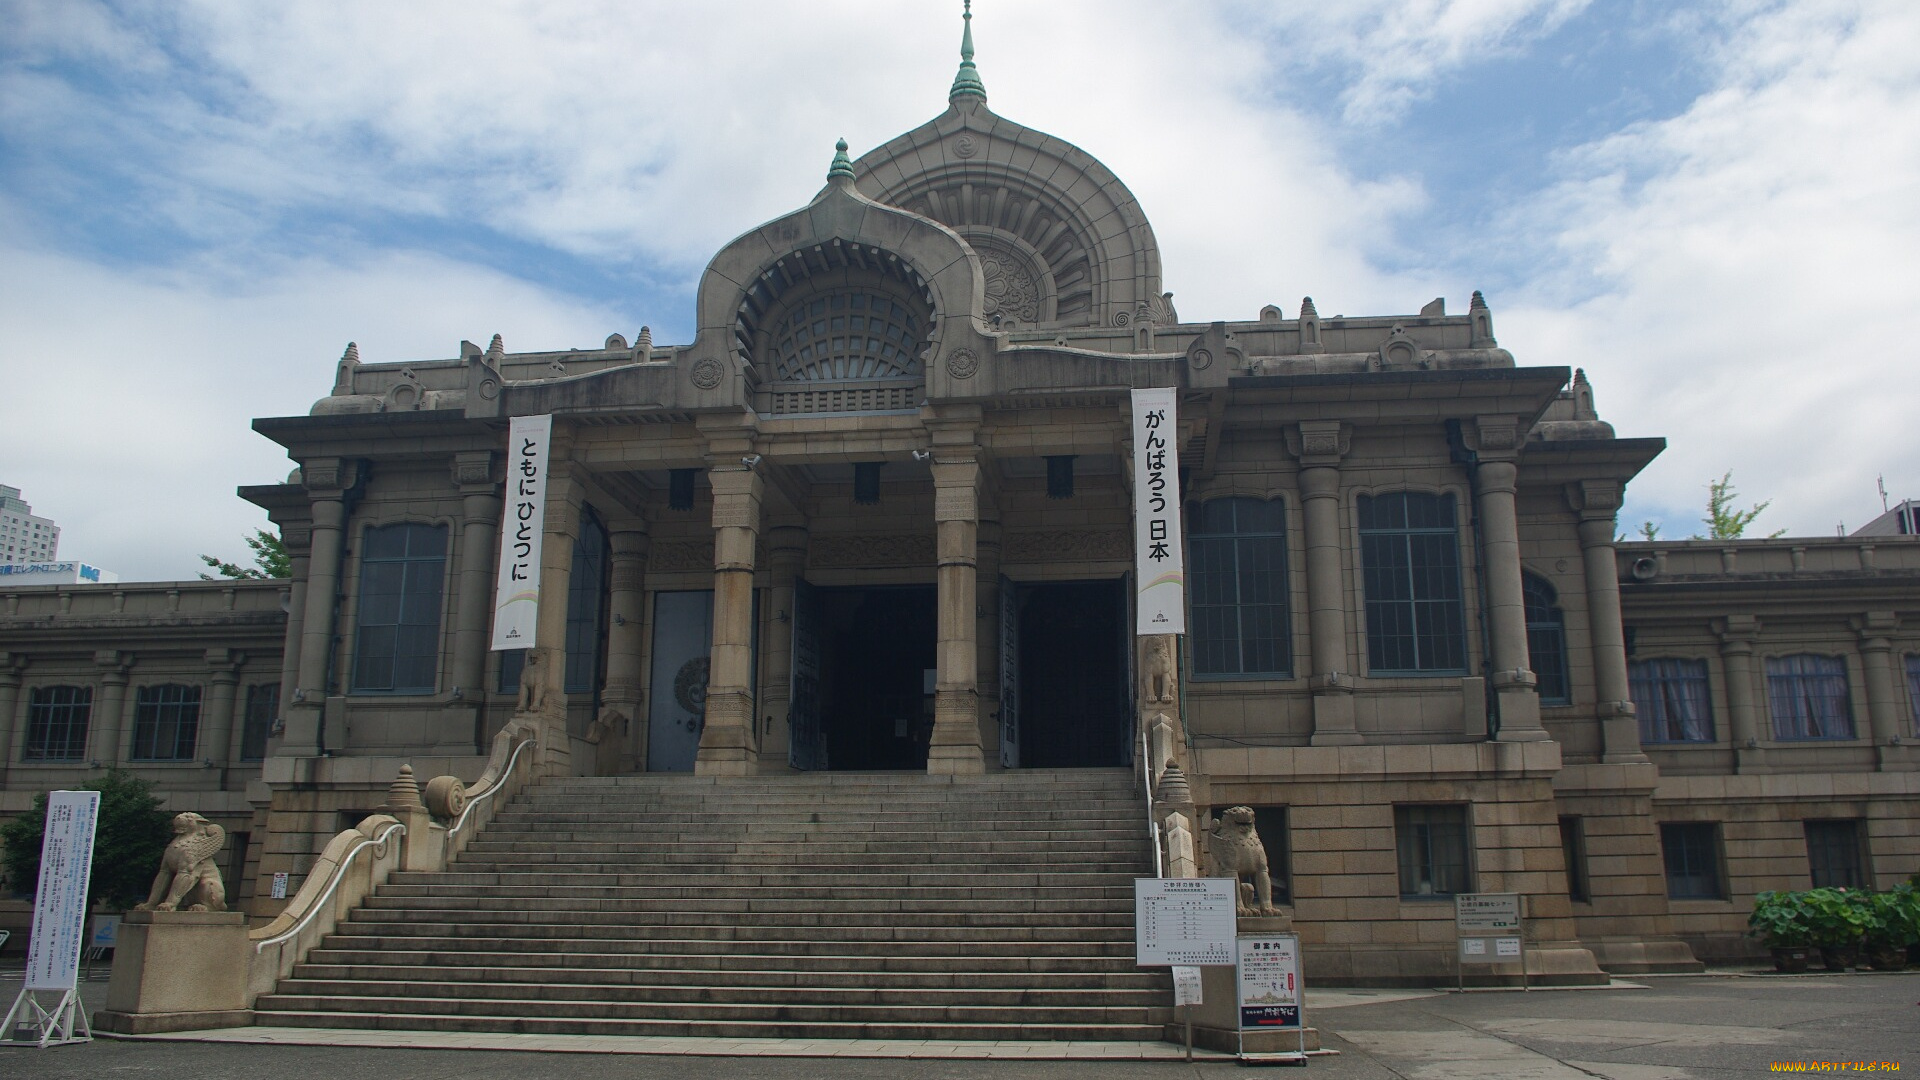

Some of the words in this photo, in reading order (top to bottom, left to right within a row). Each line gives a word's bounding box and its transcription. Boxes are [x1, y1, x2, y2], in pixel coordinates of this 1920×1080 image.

[511, 437, 537, 581] ともにひとつに
[1253, 942, 1281, 950] 御案内
